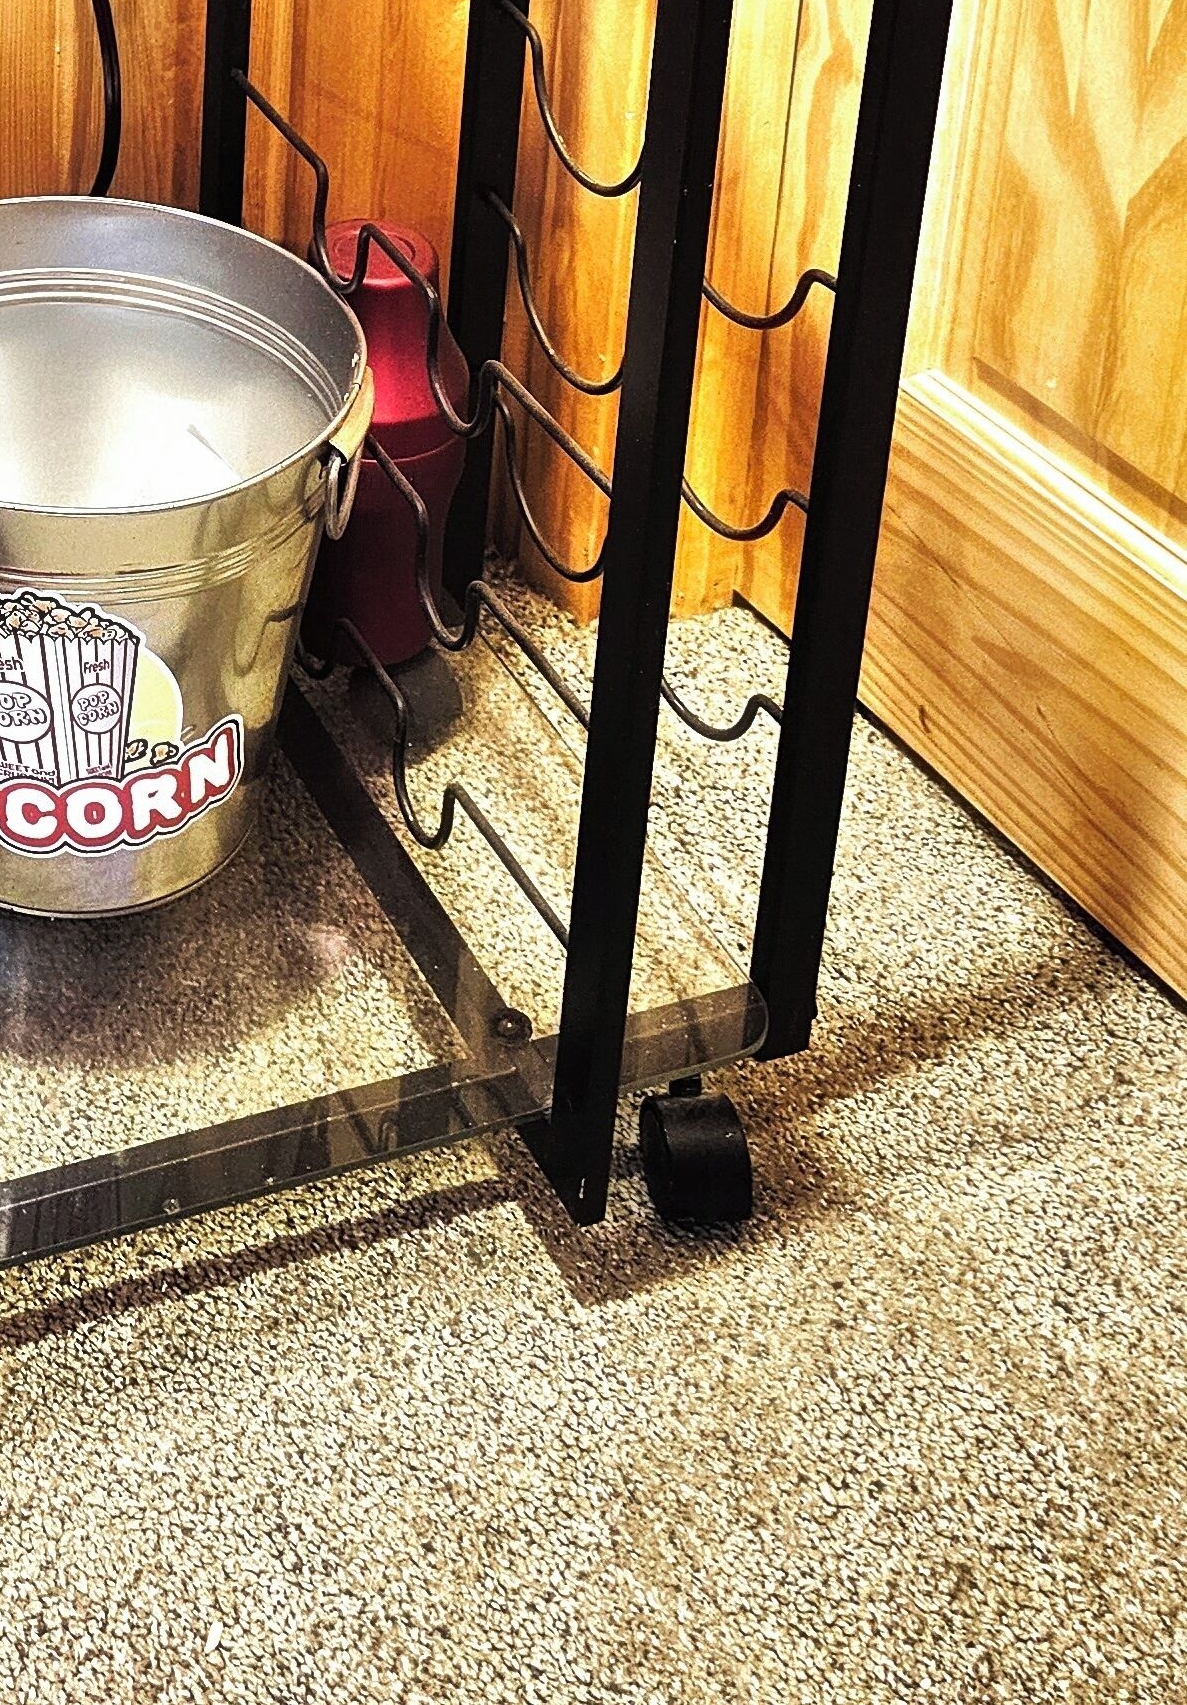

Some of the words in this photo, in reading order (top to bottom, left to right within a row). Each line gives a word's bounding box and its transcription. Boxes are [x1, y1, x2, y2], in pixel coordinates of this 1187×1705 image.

[83, 659, 110, 675] Fresh
[77, 690, 110, 712] POP
[77, 700, 120, 727] CORN
[31, 767, 56, 777] and
